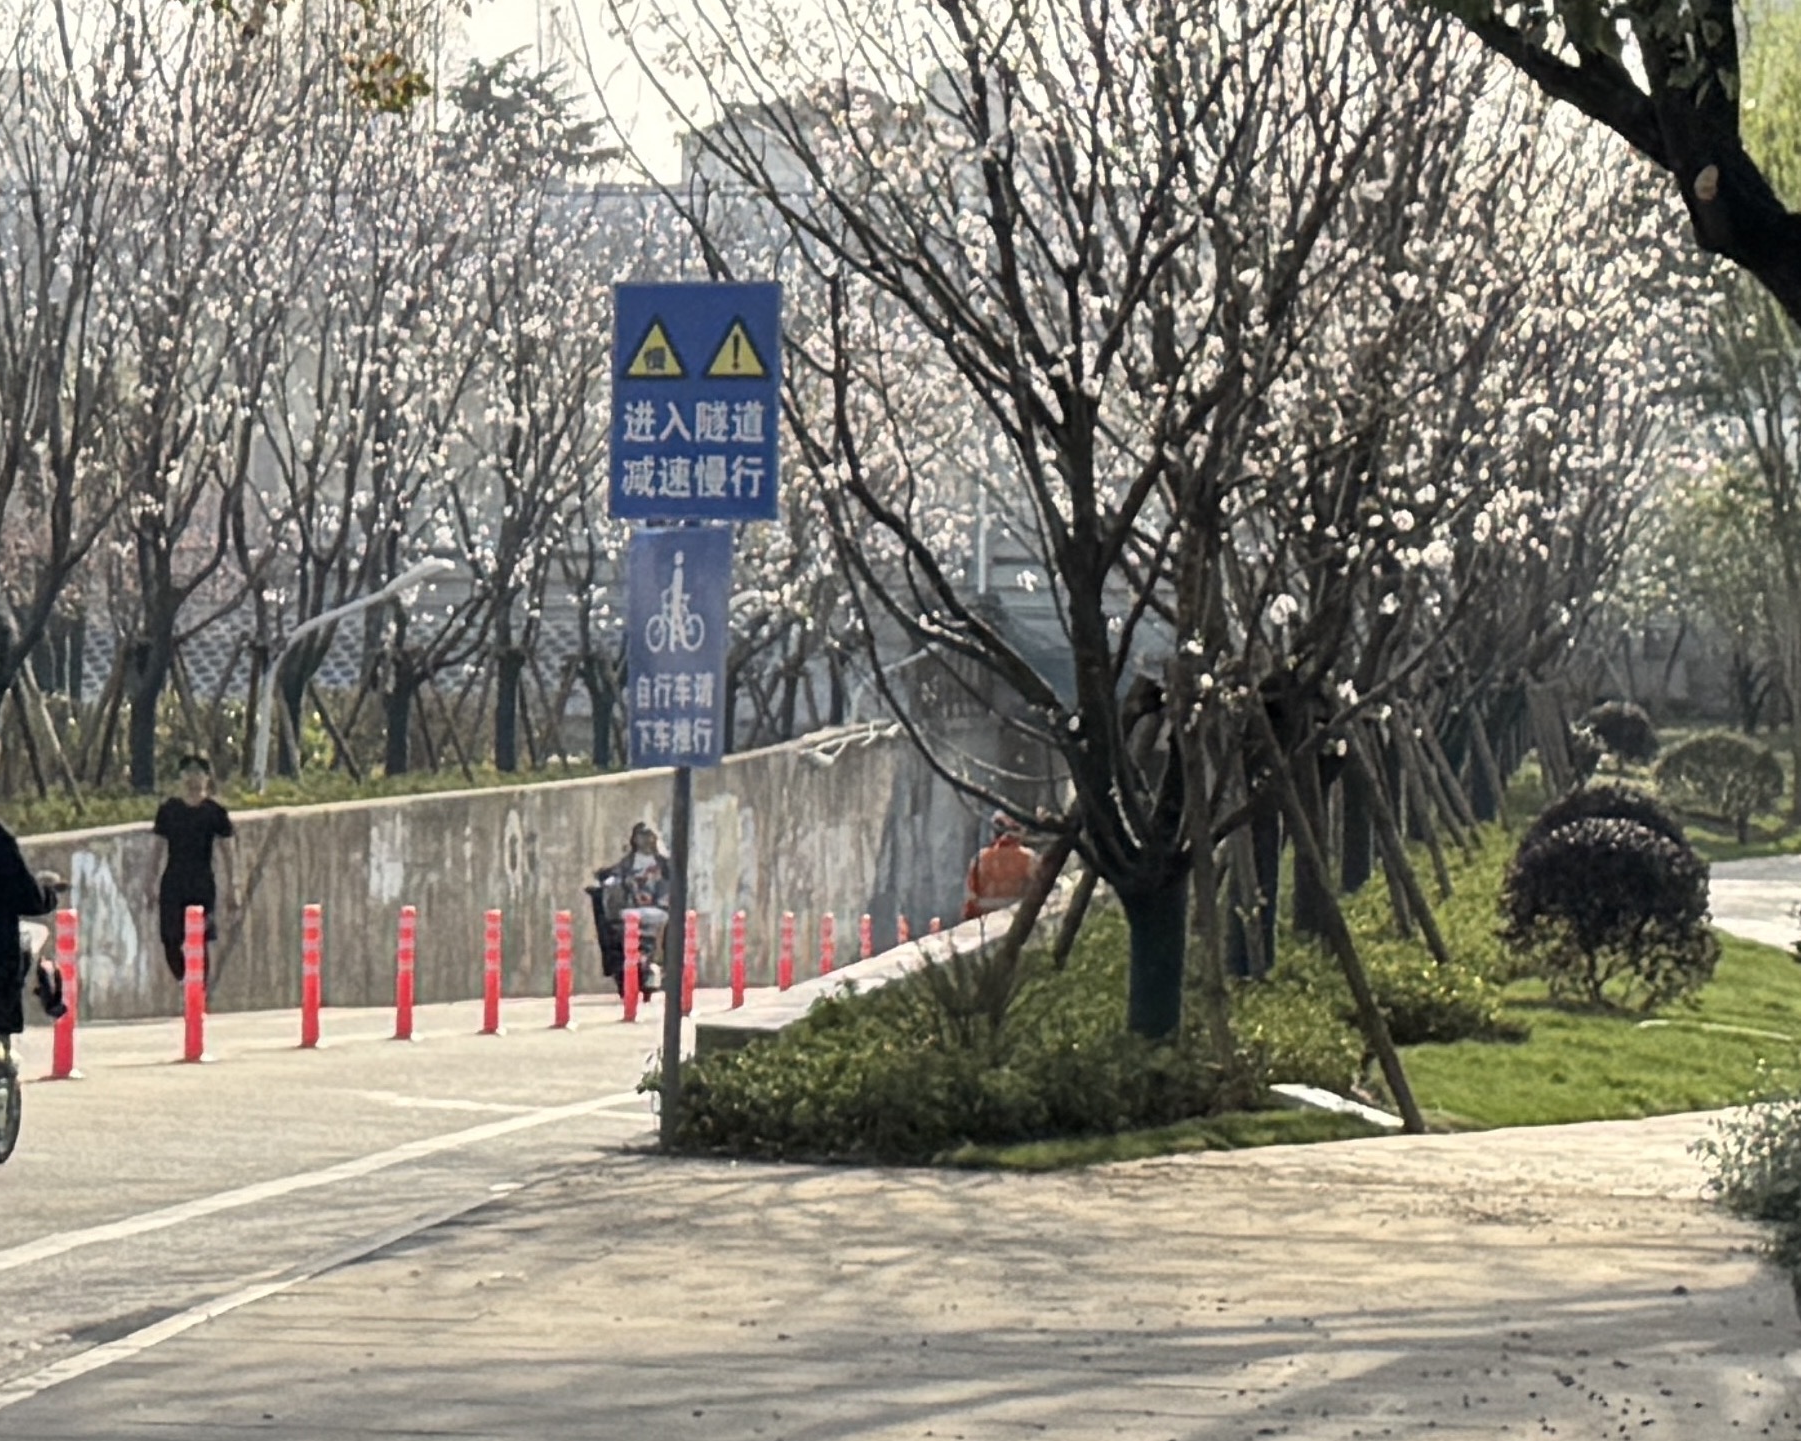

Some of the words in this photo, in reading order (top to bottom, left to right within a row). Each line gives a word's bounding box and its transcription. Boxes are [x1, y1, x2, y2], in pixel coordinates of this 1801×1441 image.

[623, 400, 765, 442] 进入隧道
[621, 455, 765, 498] 减速慢行
[637, 672, 714, 709] 自行车请
[635, 718, 713, 754] 下车推行
